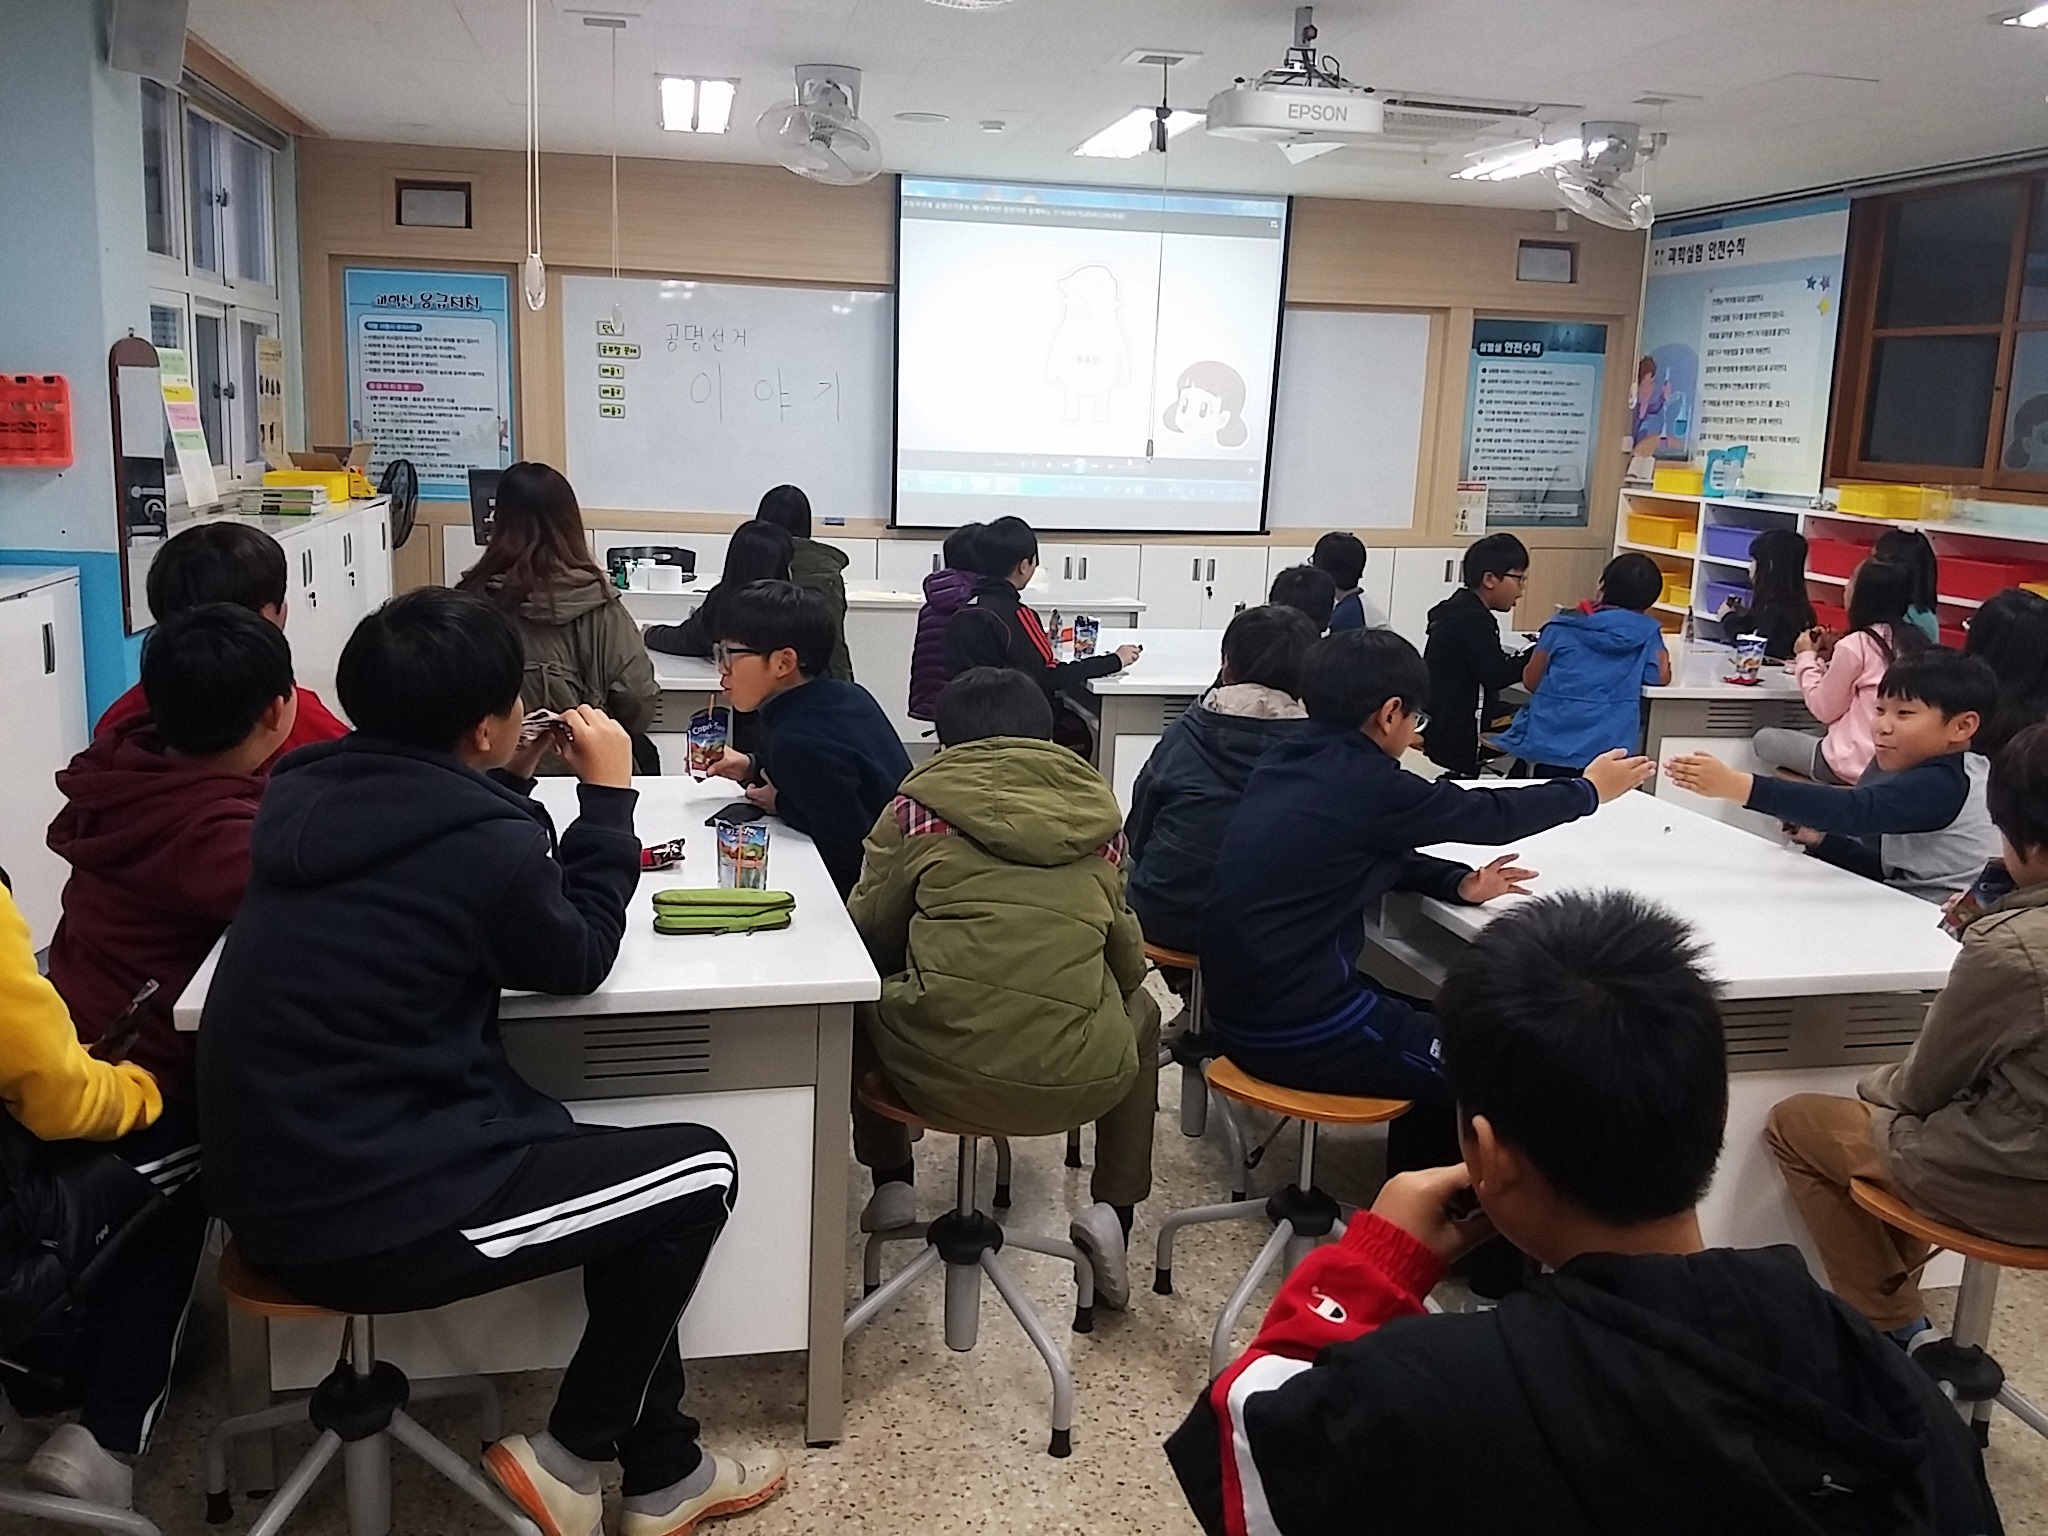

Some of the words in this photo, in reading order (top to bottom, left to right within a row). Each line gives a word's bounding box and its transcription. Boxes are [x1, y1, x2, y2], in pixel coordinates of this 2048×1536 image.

[1288, 104, 1348, 121] EPSON
[1668, 244, 1704, 266] 과학실험
[1708, 237, 1746, 261] 안전수칙
[377, 294, 414, 309] 과학실
[420, 292, 479, 311] 응급처치
[665, 323, 746, 352] 공명선거
[1504, 341, 1542, 355] 안전수칙
[690, 363, 840, 423] 이야기
